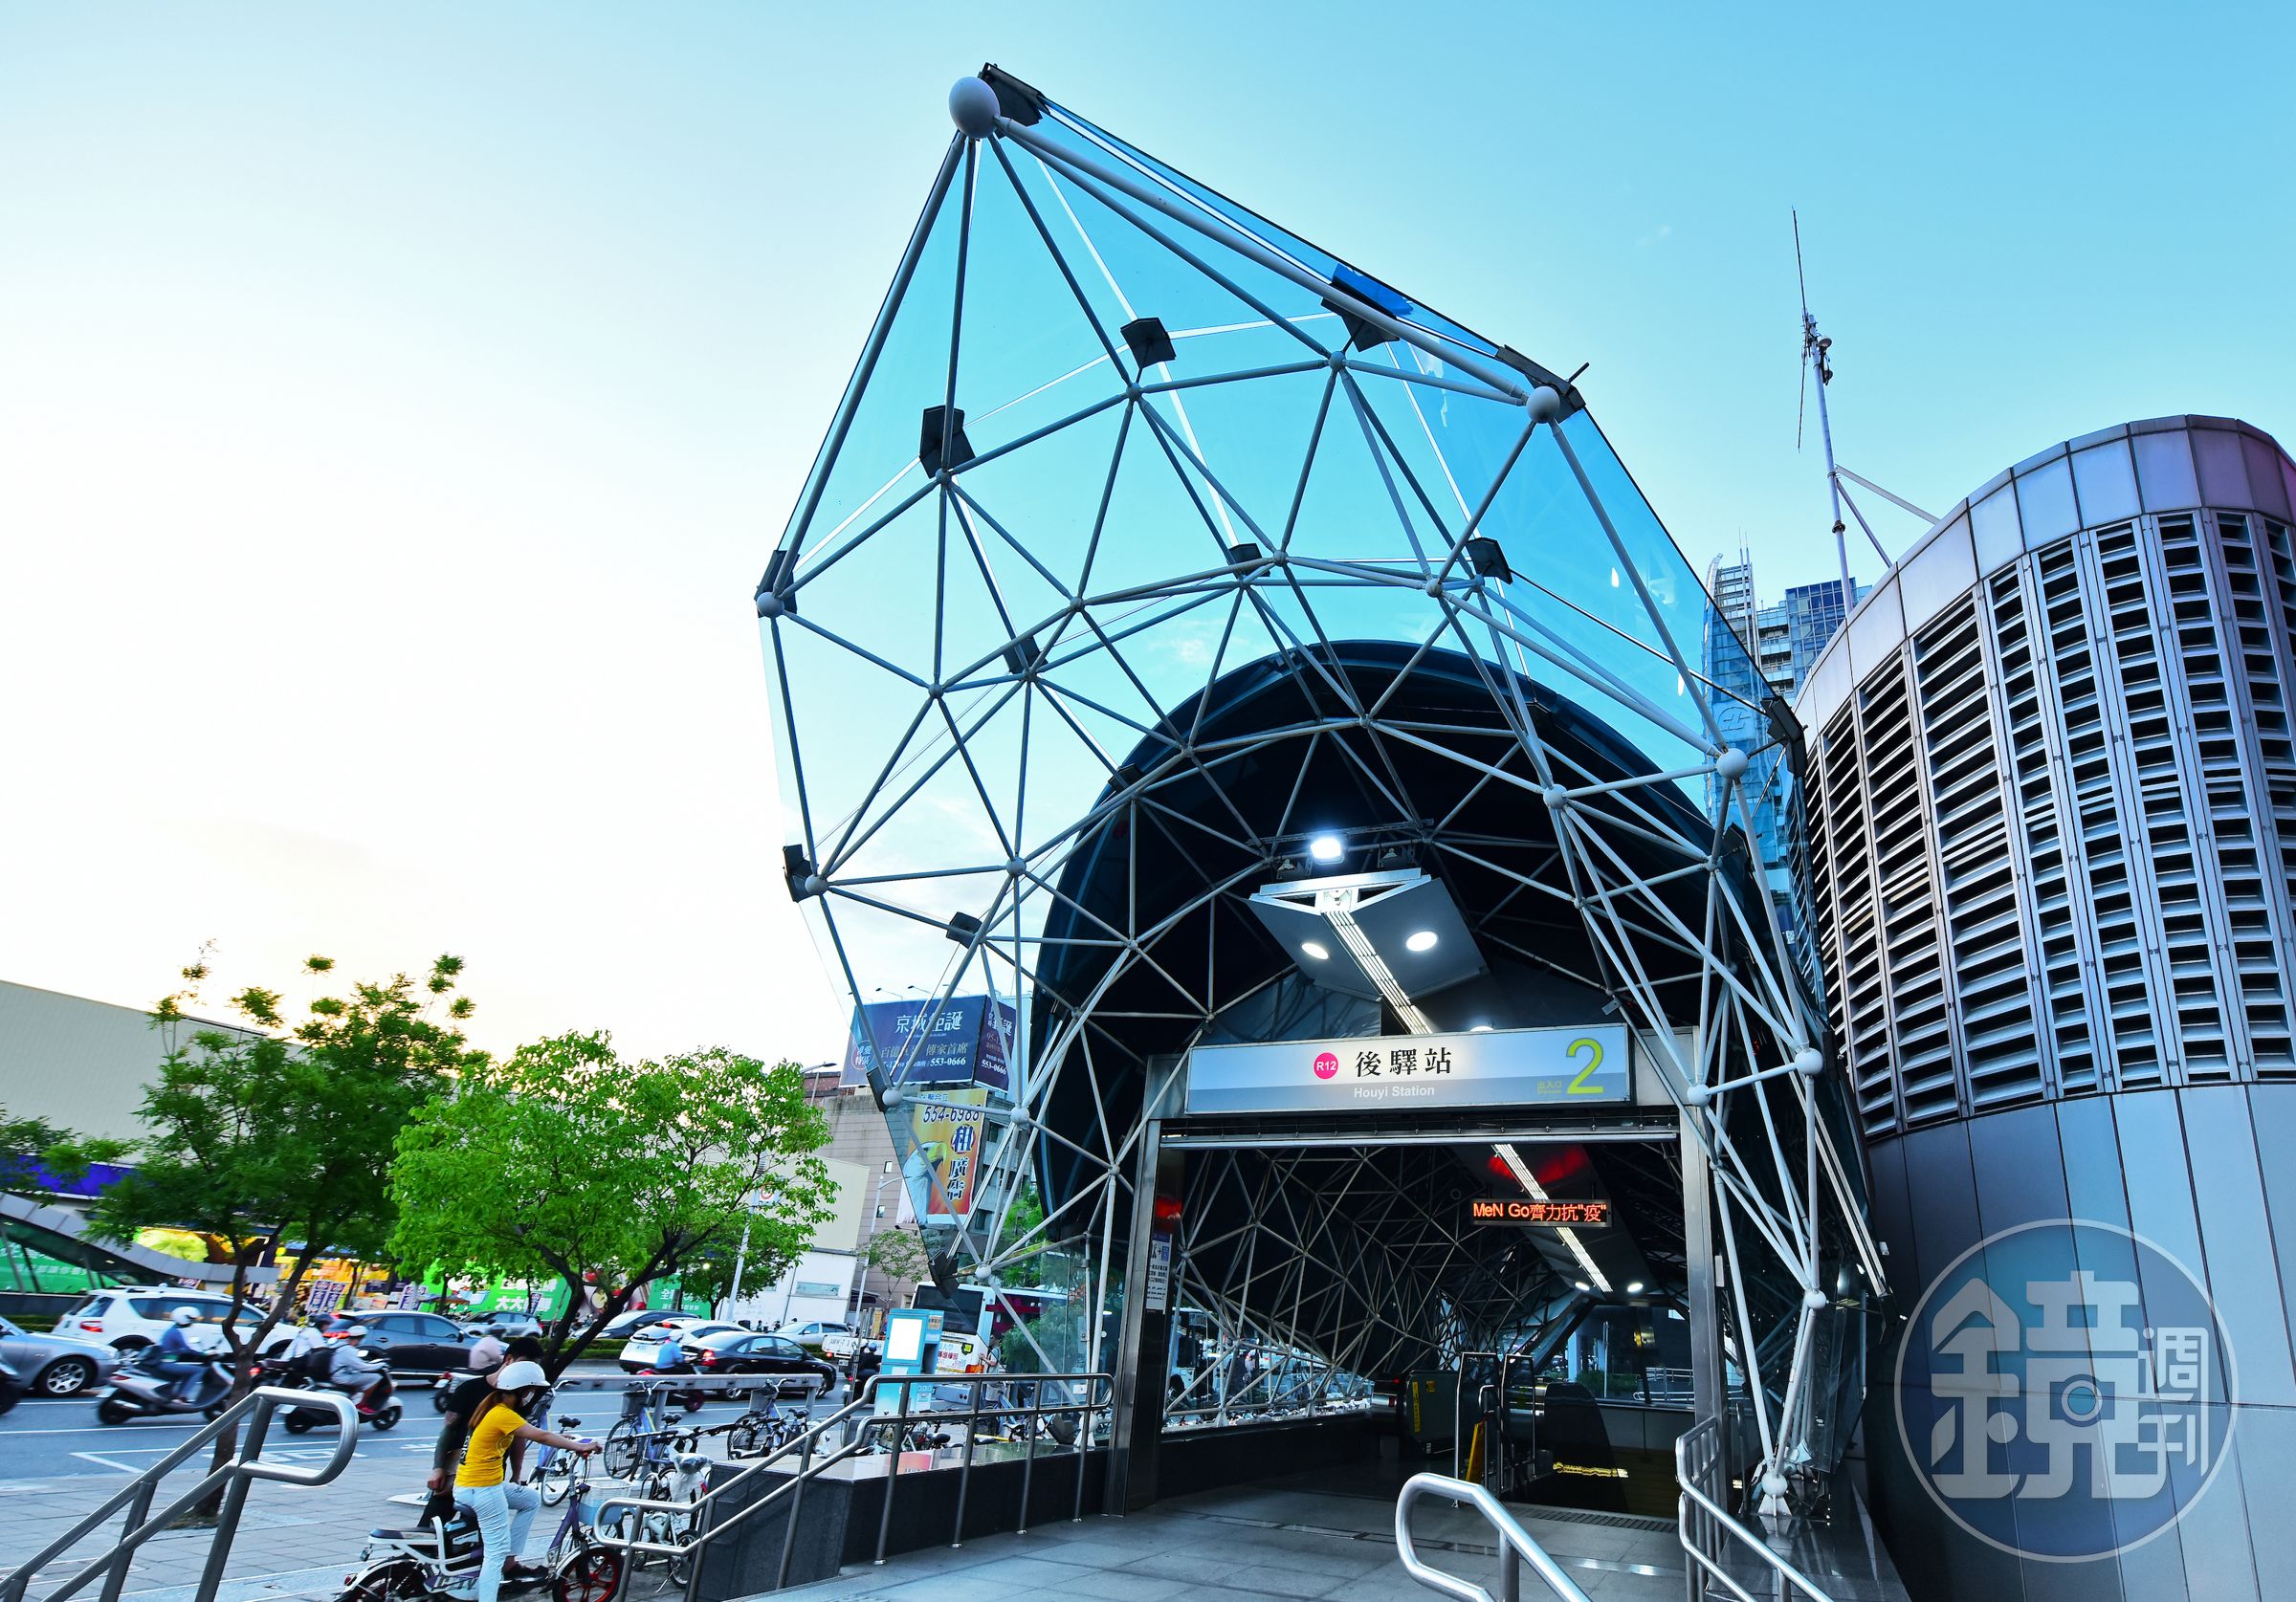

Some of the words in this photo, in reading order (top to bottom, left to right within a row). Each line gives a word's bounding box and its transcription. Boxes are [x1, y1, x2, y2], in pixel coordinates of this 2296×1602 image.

[930, 1056, 966, 1067] 553-0666
[1316, 1061, 1336, 1071] R12
[1355, 1046, 1451, 1078] 後驛站
[1566, 1038, 1603, 1094] 2
[1354, 1086, 1388, 1100] Houyi
[1392, 1085, 1435, 1097] Station
[1473, 1203, 1503, 1218] MeN
